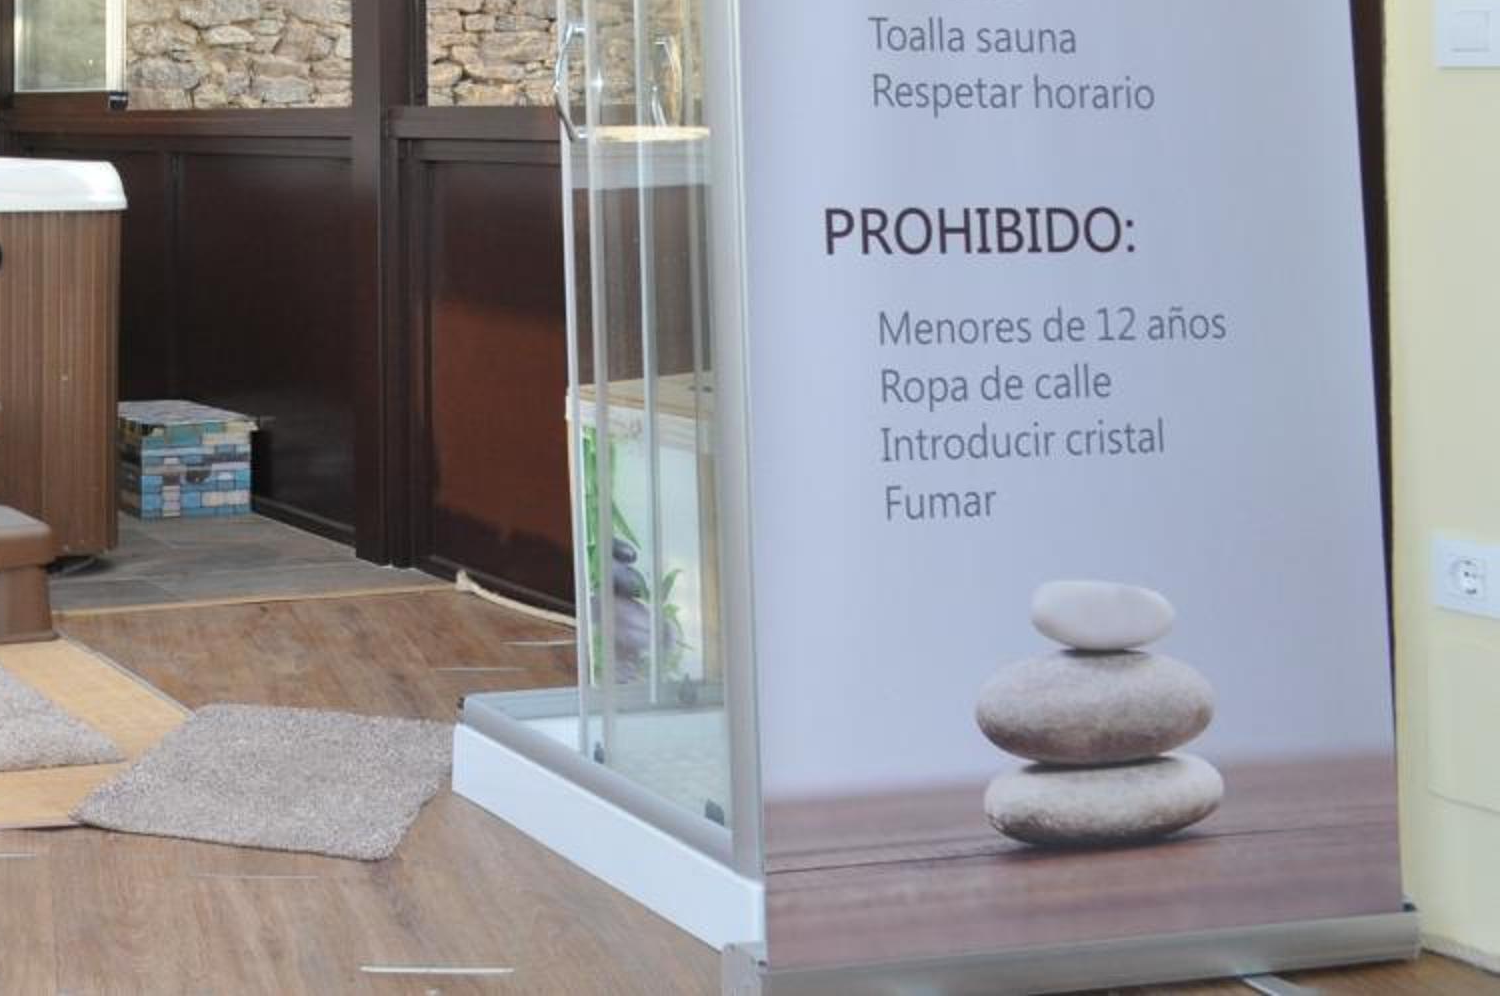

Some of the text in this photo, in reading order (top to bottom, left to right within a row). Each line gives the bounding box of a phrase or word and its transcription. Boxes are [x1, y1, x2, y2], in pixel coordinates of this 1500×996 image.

[869, 17, 1076, 54] Toalla sauna
[873, 74, 1154, 117] Respetar horario
[825, 206, 1135, 256] PROHIBIDO:
[878, 305, 1226, 346] Menores de 12 años
[882, 364, 1111, 411] Ropa de calle
[881, 419, 1165, 462] Introducir cristal
[886, 485, 996, 520] Fumar
